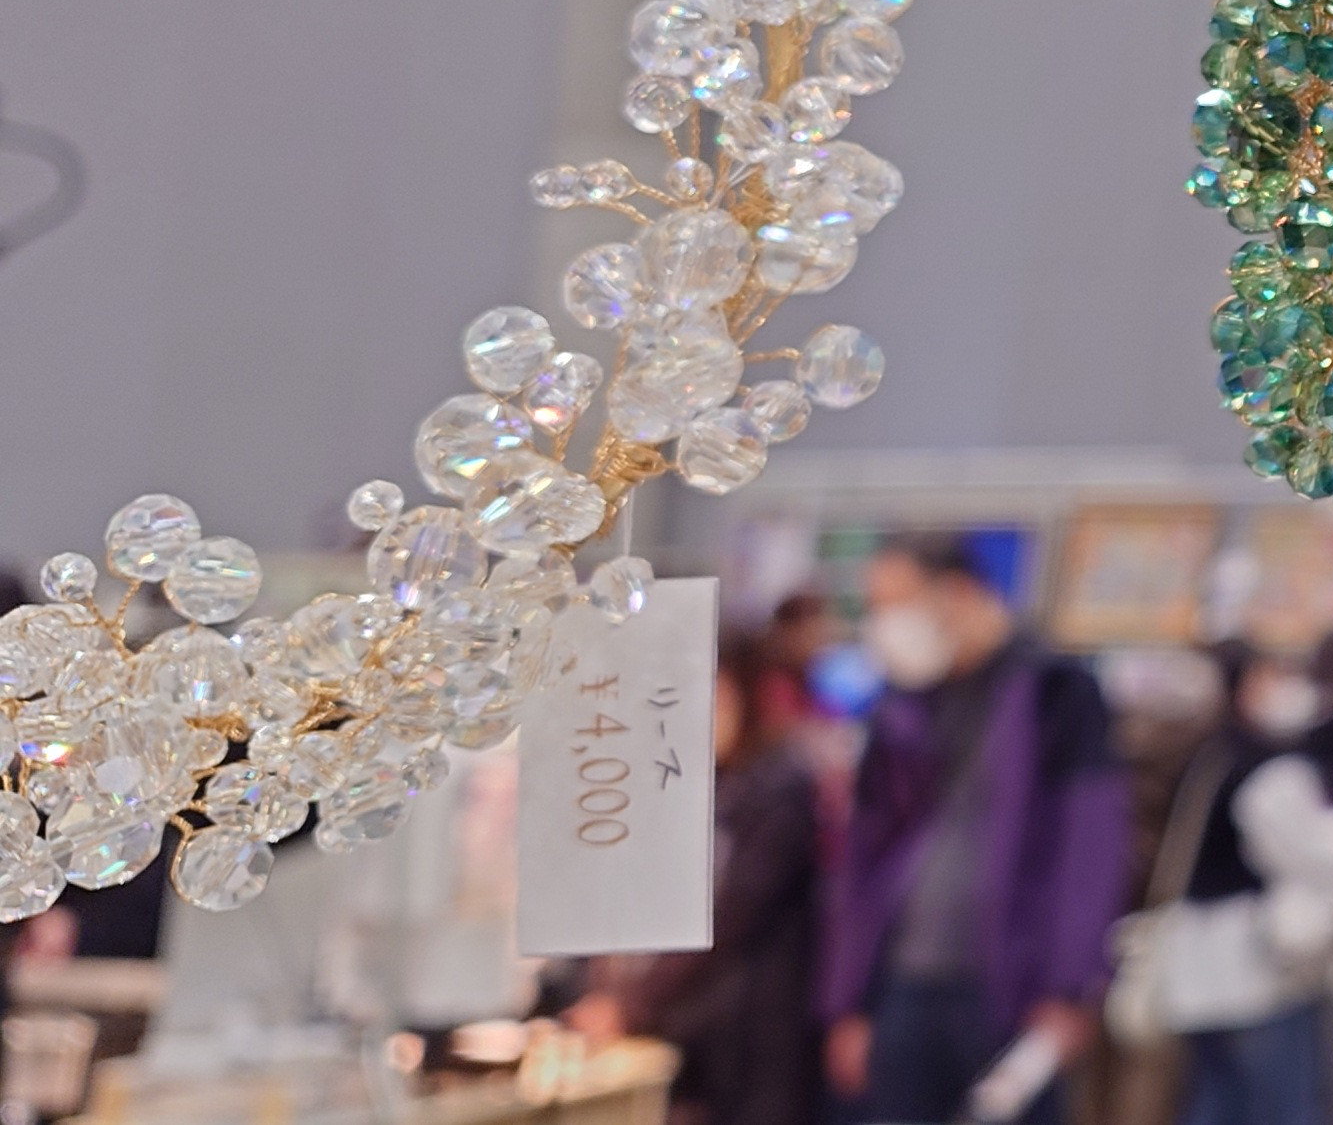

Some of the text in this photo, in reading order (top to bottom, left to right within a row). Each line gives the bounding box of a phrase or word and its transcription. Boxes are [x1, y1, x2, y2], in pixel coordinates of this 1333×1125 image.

[572, 675, 631, 845] ¥4,000
[648, 687, 682, 790] リース
